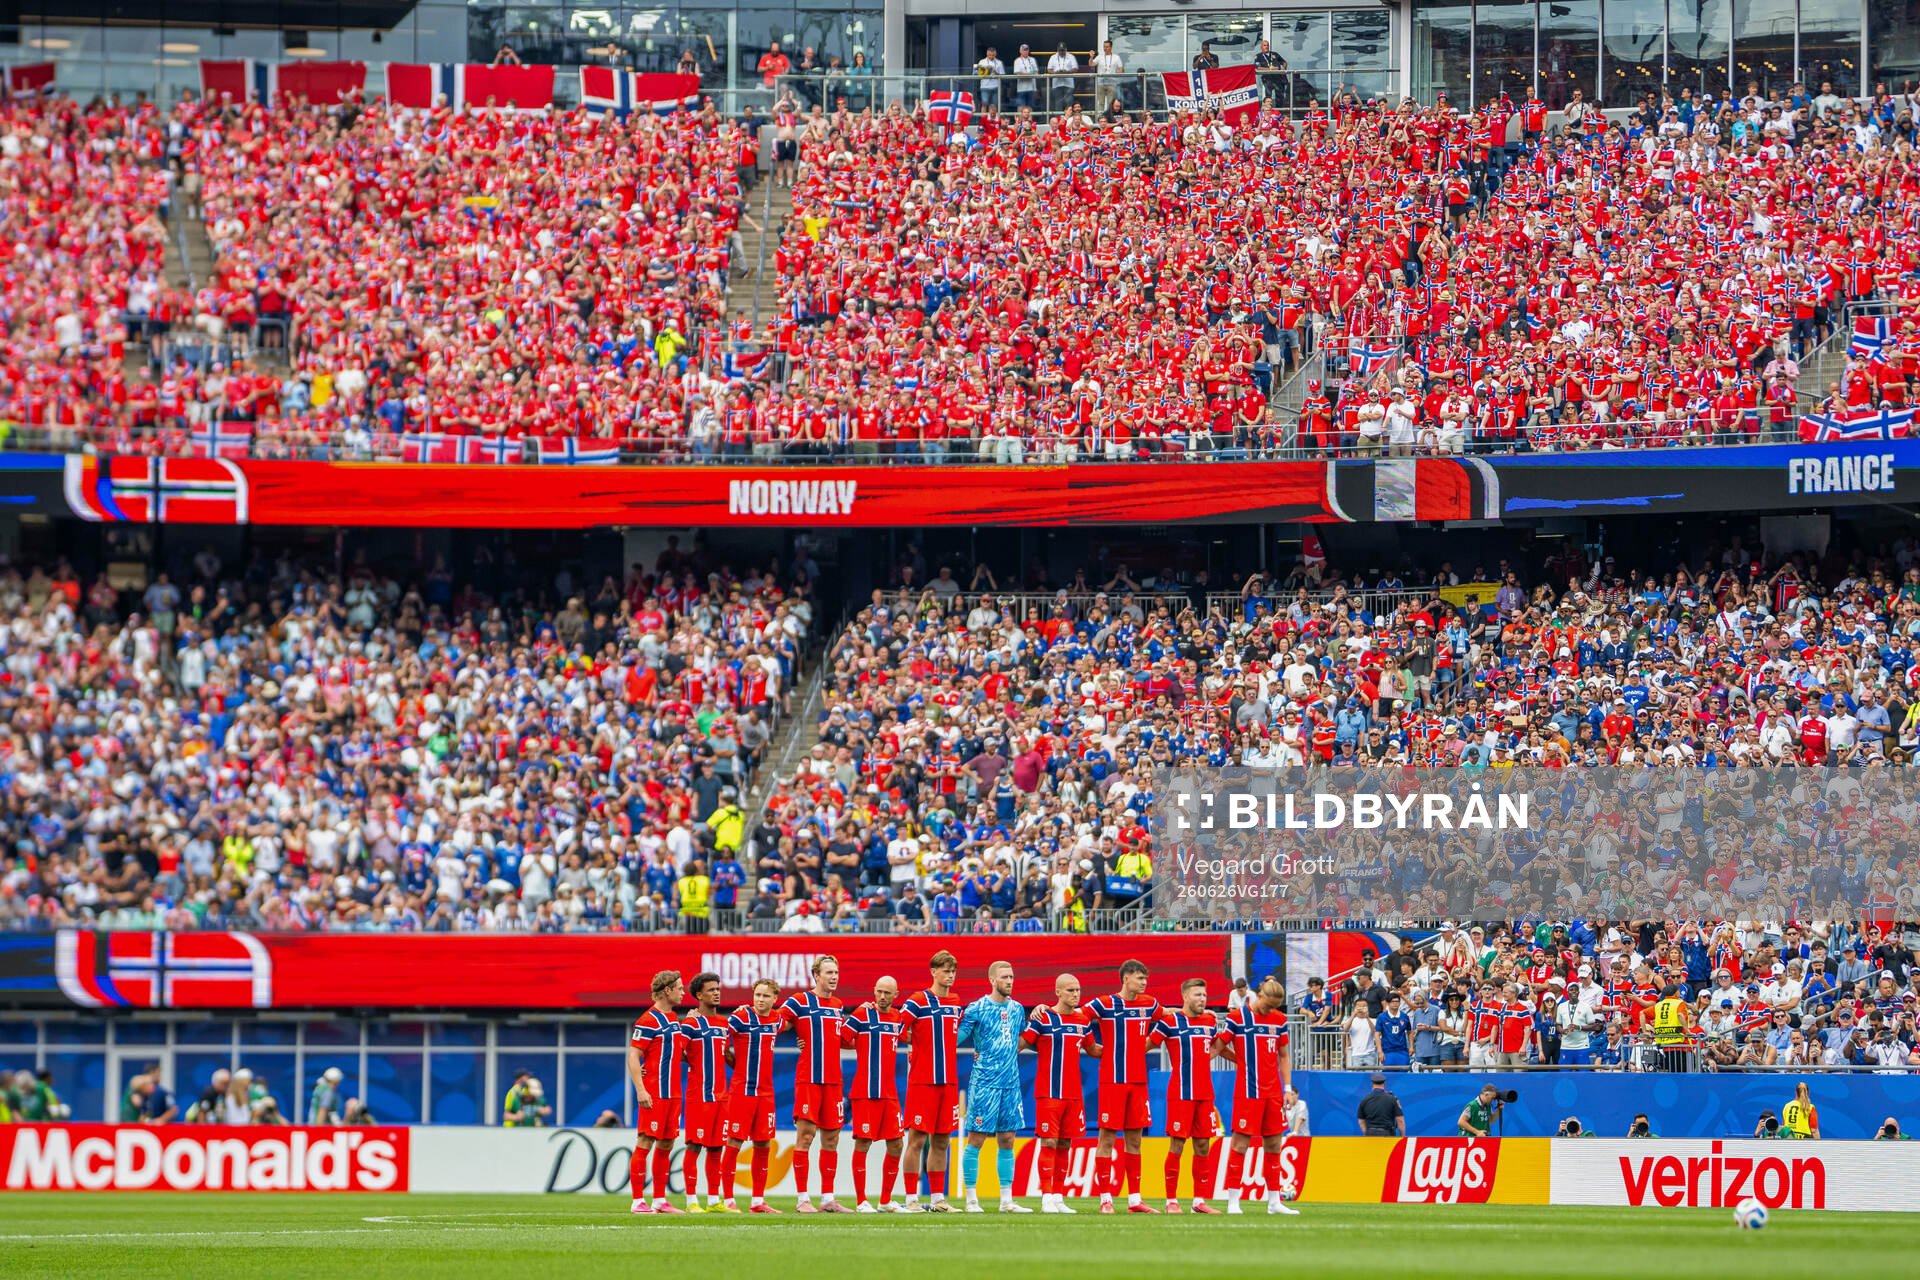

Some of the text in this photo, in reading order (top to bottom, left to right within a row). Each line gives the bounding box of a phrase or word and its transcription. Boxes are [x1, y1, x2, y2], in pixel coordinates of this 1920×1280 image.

[1174, 91, 1250, 109] KONGSVNGER
[1788, 454, 1895, 494] FRANCE
[729, 479, 857, 515] NORWAY
[1344, 867, 1383, 877] FRANCE
[1139, 1021, 1147, 1035] 11
[6, 1128, 398, 1190] McDonald's
[546, 1128, 690, 1194] Doe
[1397, 1137, 1487, 1204] Lay's
[1619, 1141, 1825, 1209] verizon
